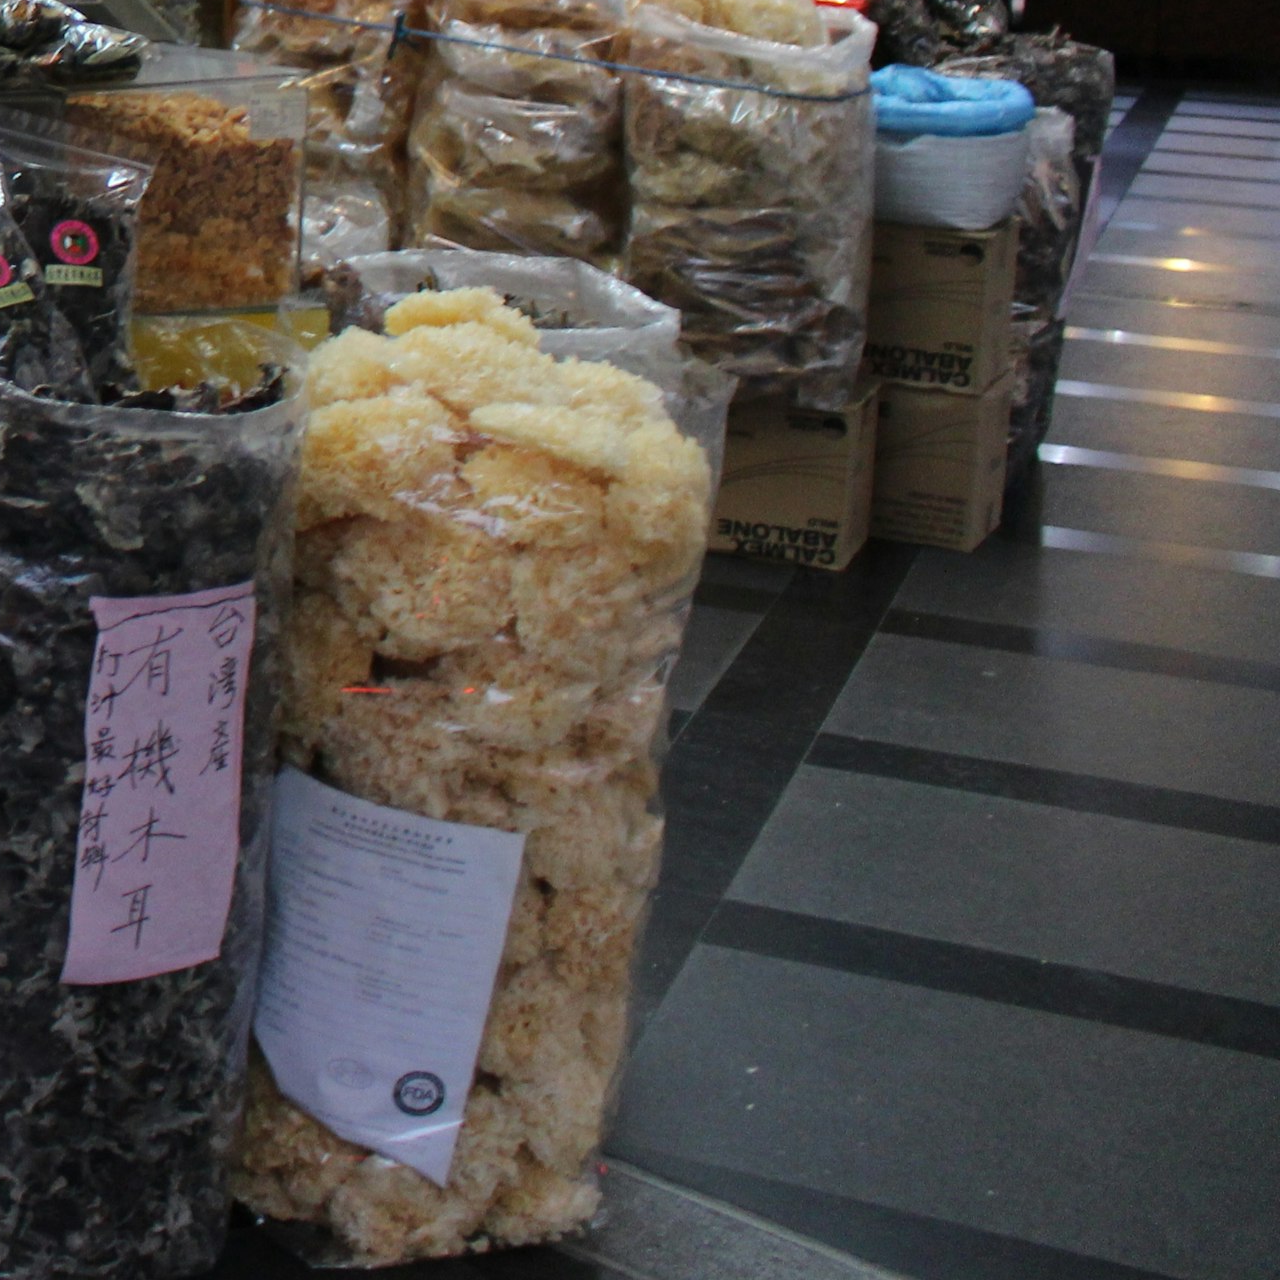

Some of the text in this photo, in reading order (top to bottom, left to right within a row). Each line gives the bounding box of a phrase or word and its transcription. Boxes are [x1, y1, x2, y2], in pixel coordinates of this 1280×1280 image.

[717, 518, 839, 548] ABALONE
[731, 538, 838, 567] CALMEX
[110, 625, 188, 950] 有機木耳
